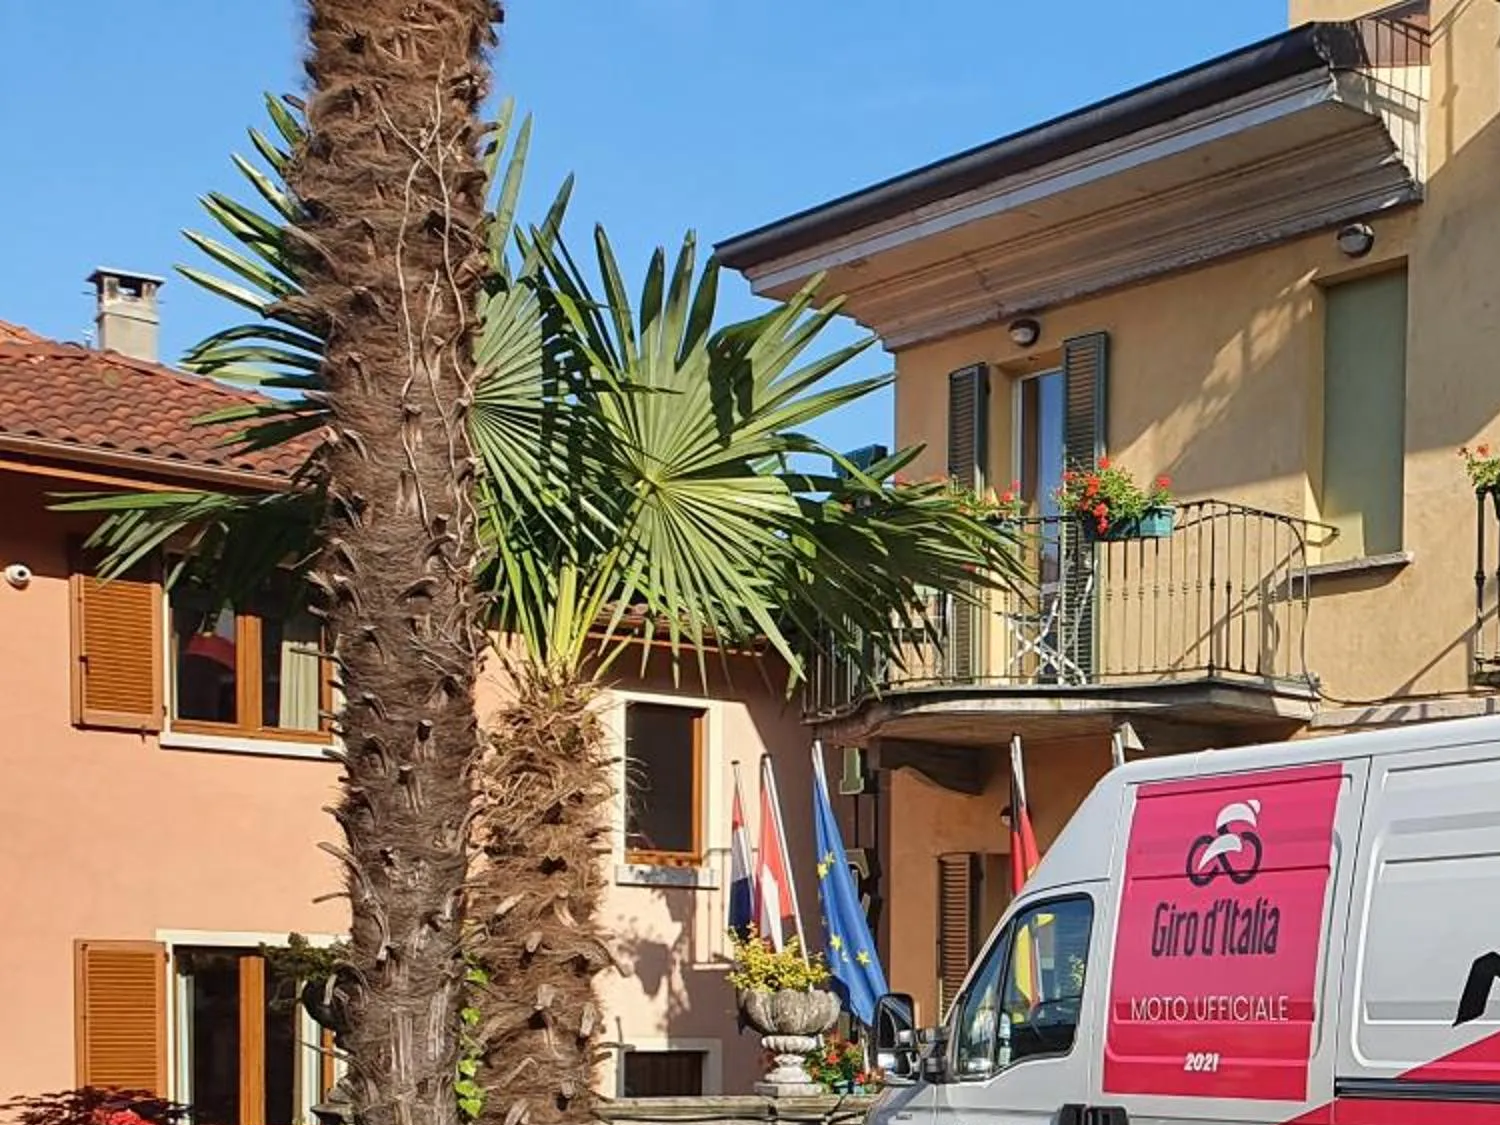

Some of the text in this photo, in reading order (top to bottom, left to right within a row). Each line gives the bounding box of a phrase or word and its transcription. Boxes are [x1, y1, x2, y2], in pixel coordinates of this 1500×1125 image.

[1151, 897, 1281, 957] Giro d'Italia
[1130, 995, 1289, 1022] MOTO UFFICIALE
[1183, 1053, 1220, 1072] 2021
